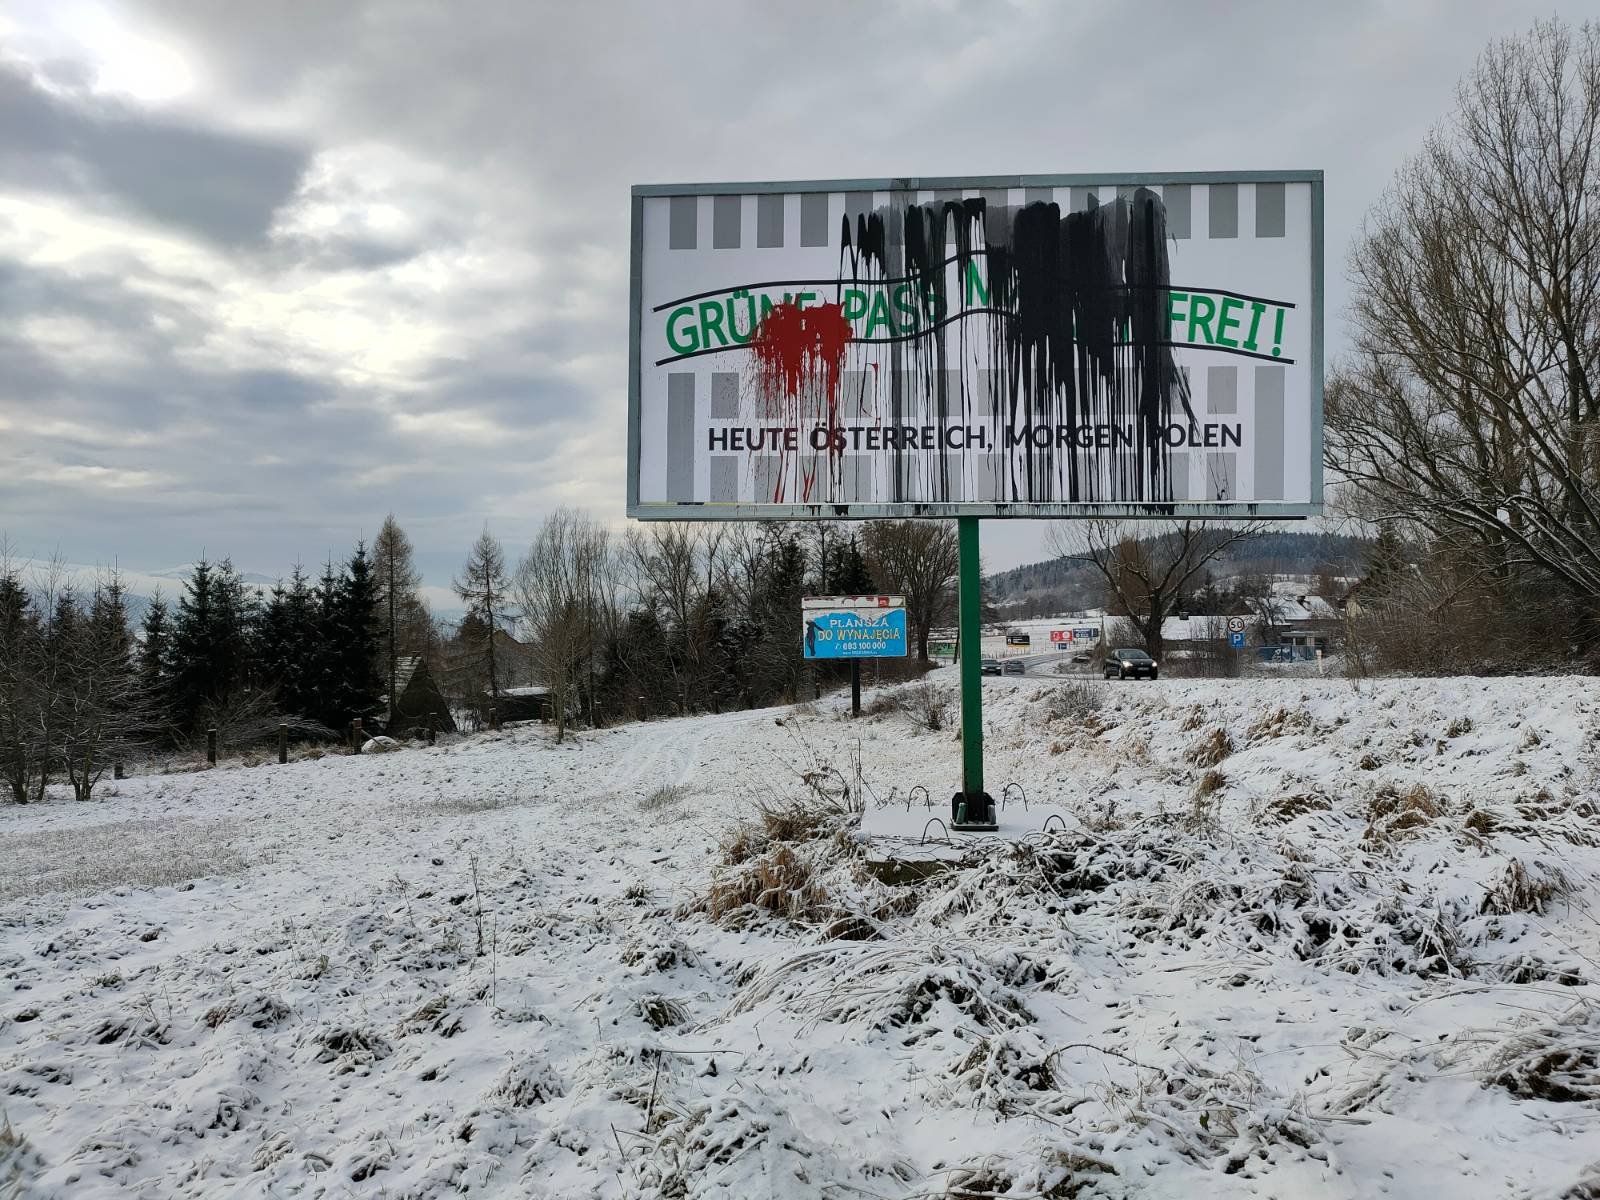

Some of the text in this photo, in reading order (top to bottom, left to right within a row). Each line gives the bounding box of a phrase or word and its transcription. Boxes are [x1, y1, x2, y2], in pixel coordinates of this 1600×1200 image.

[1165, 292, 1286, 357] FREI!
[709, 427, 798, 451] HEUTE
[810, 422, 993, 453] ÖSTERREICH,
[1005, 423, 1133, 448] MORGEN
[830, 618, 889, 628] PLANSZA
[818, 629, 833, 641] DO
